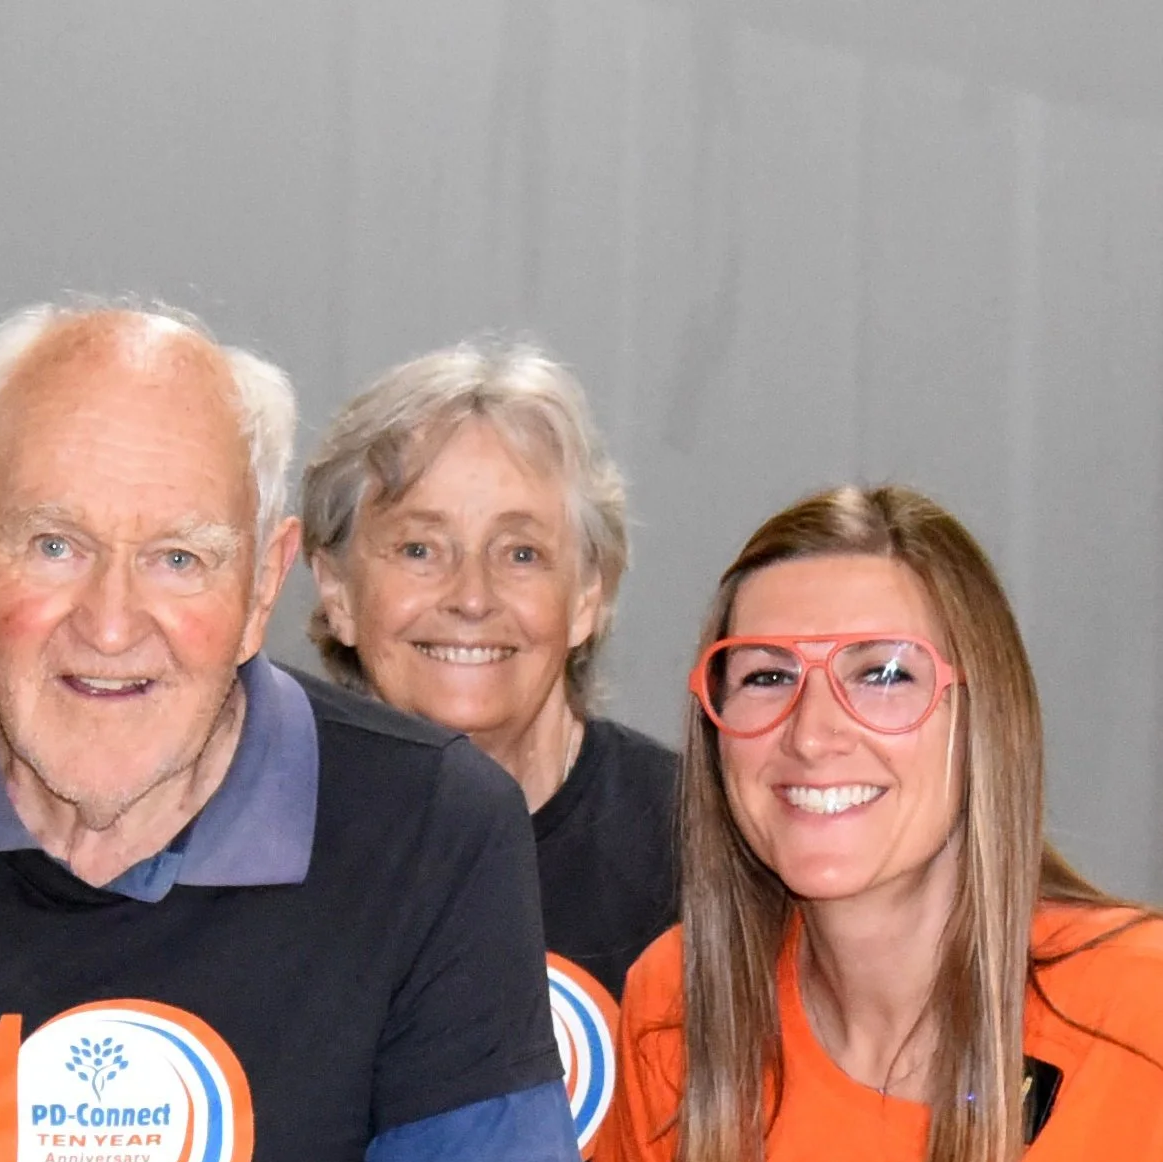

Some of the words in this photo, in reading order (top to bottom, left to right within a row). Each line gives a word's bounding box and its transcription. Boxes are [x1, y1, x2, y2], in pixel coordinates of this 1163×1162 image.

[32, 1103, 170, 1127] PD-Connect
[36, 1133, 86, 1147] TEN
[94, 1133, 162, 1147] YEAR
